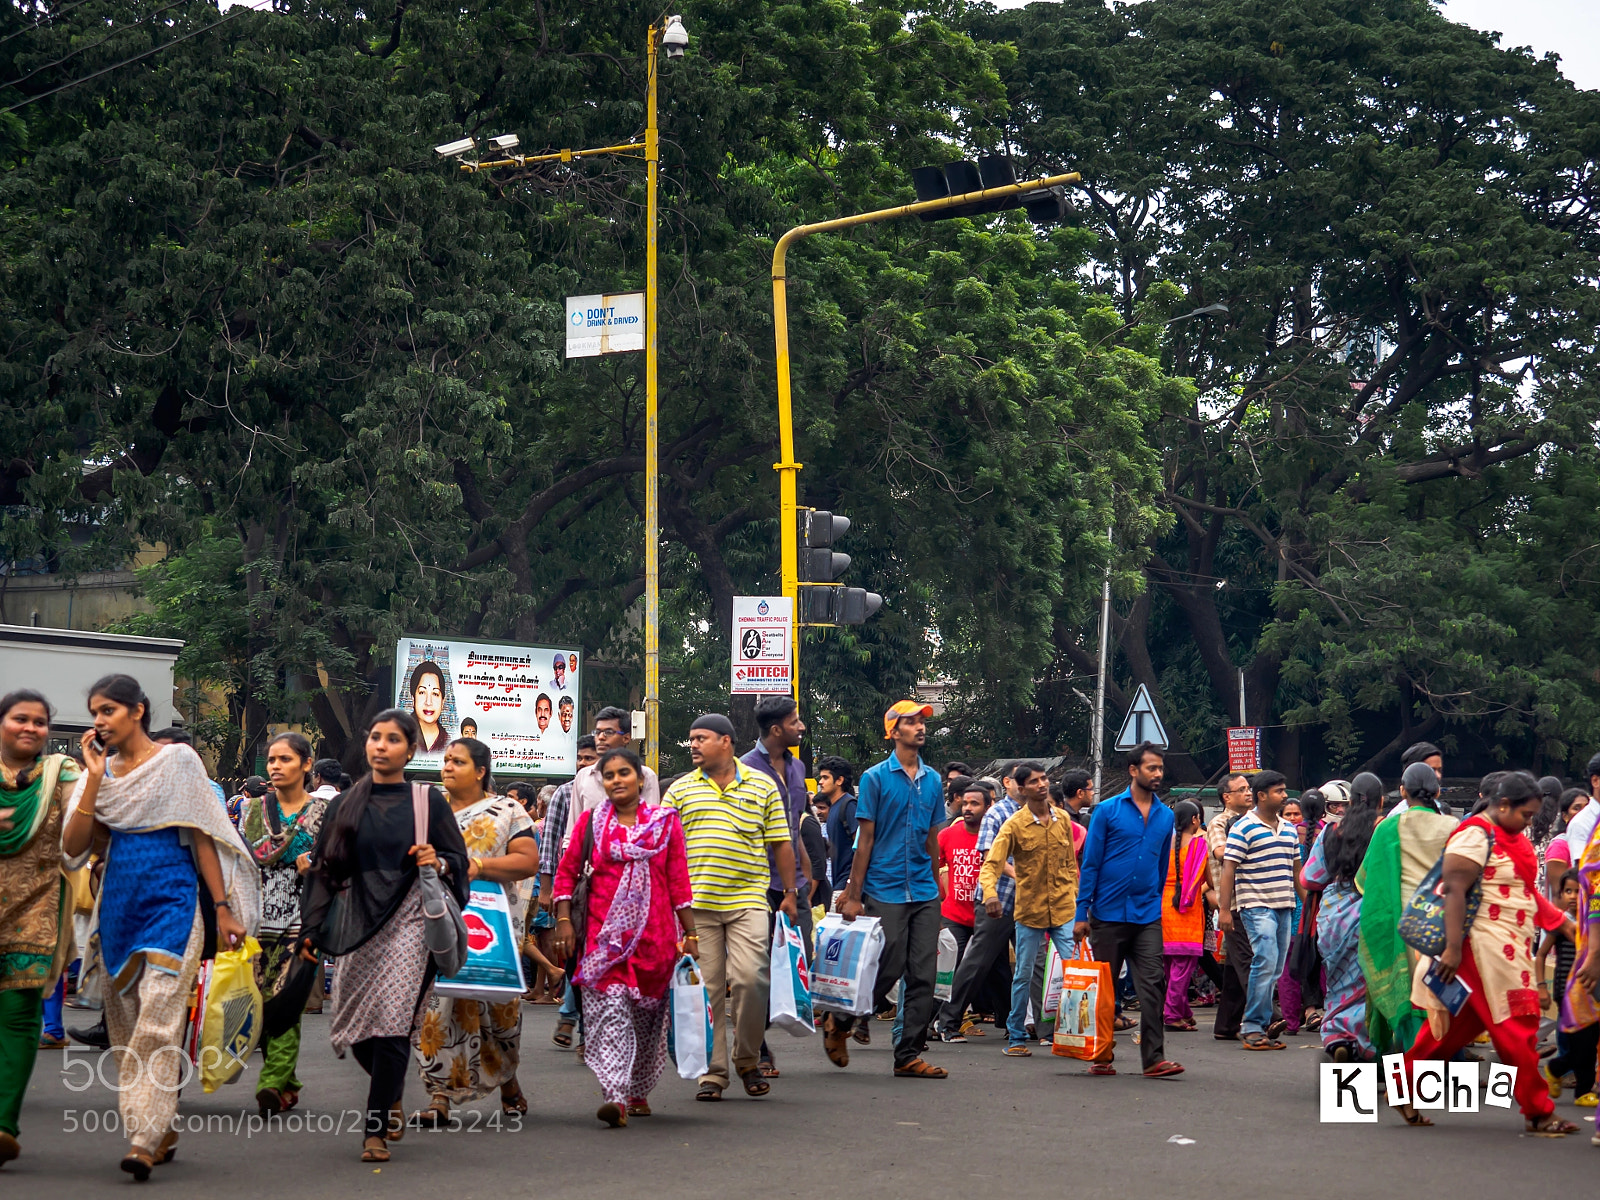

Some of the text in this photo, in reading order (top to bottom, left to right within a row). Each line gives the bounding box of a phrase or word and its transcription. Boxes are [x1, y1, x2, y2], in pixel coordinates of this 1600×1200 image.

[587, 307, 615, 319] DON'T
[587, 319, 606, 327] DRINK
[614, 317, 632, 325] DRIVE
[747, 667, 788, 677] HITECH
[953, 856, 970, 864] ACM
[953, 865, 981, 876] 2012-
[954, 889, 974, 901] TSHI
